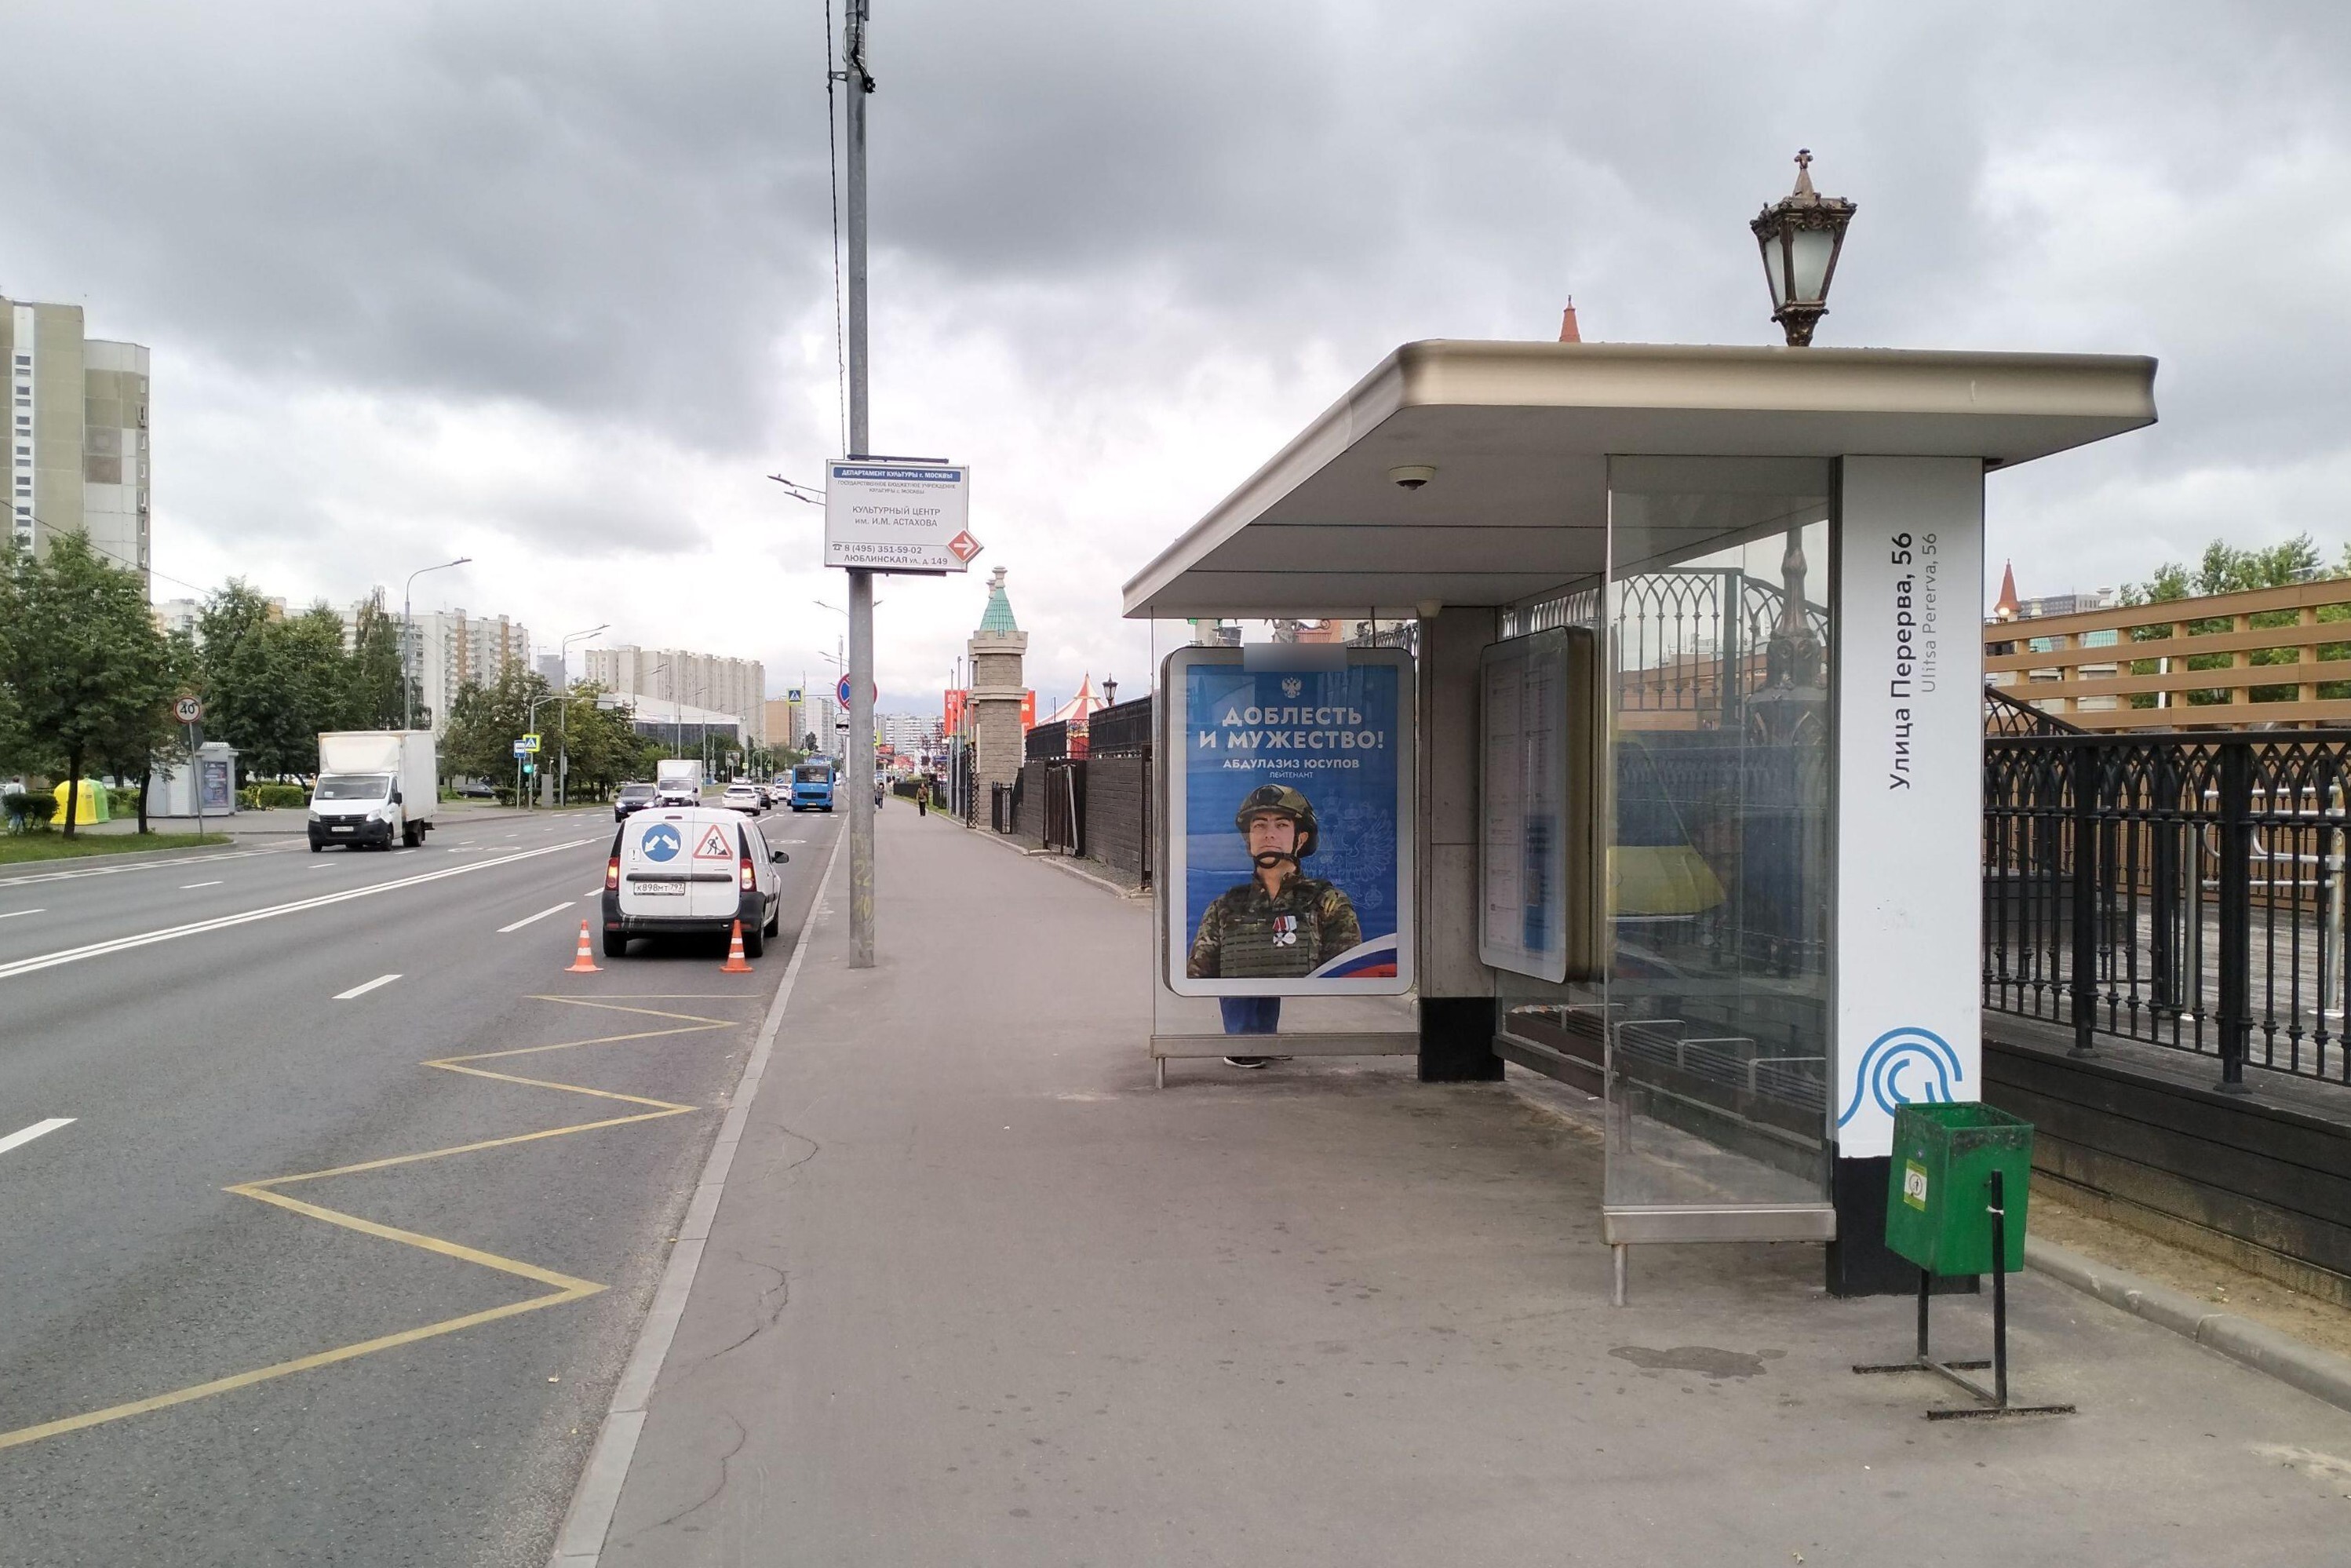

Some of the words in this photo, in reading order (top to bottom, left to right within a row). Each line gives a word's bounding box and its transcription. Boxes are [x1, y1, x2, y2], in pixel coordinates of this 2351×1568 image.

[852, 505, 909, 516] КУЛЬТУРНЫЙ
[913, 508, 940, 516] ЦЕНТР
[852, 545, 875, 553] (495)
[877, 545, 922, 554] 351-59-02
[1891, 532, 1912, 565] 56
[1922, 533, 1937, 555] 56
[1922, 560, 1938, 633] Pererva,
[1890, 573, 1916, 698] Перерва,
[1921, 640, 1937, 693] Ulitsa
[180, 705, 195, 715] 40
[1222, 706, 1362, 727] ДОБЛЕСТЬ
[1199, 731, 1216, 749] И
[1227, 731, 1384, 749] МУЖЕСТВО!
[1890, 708, 1914, 790] Улица
[1223, 759, 1300, 770] АБДУЛАЗИЗ
[1304, 759, 1360, 769] ЮСУПОВ
[1269, 770, 1314, 779] ЛЕЙТЕНАНТ
